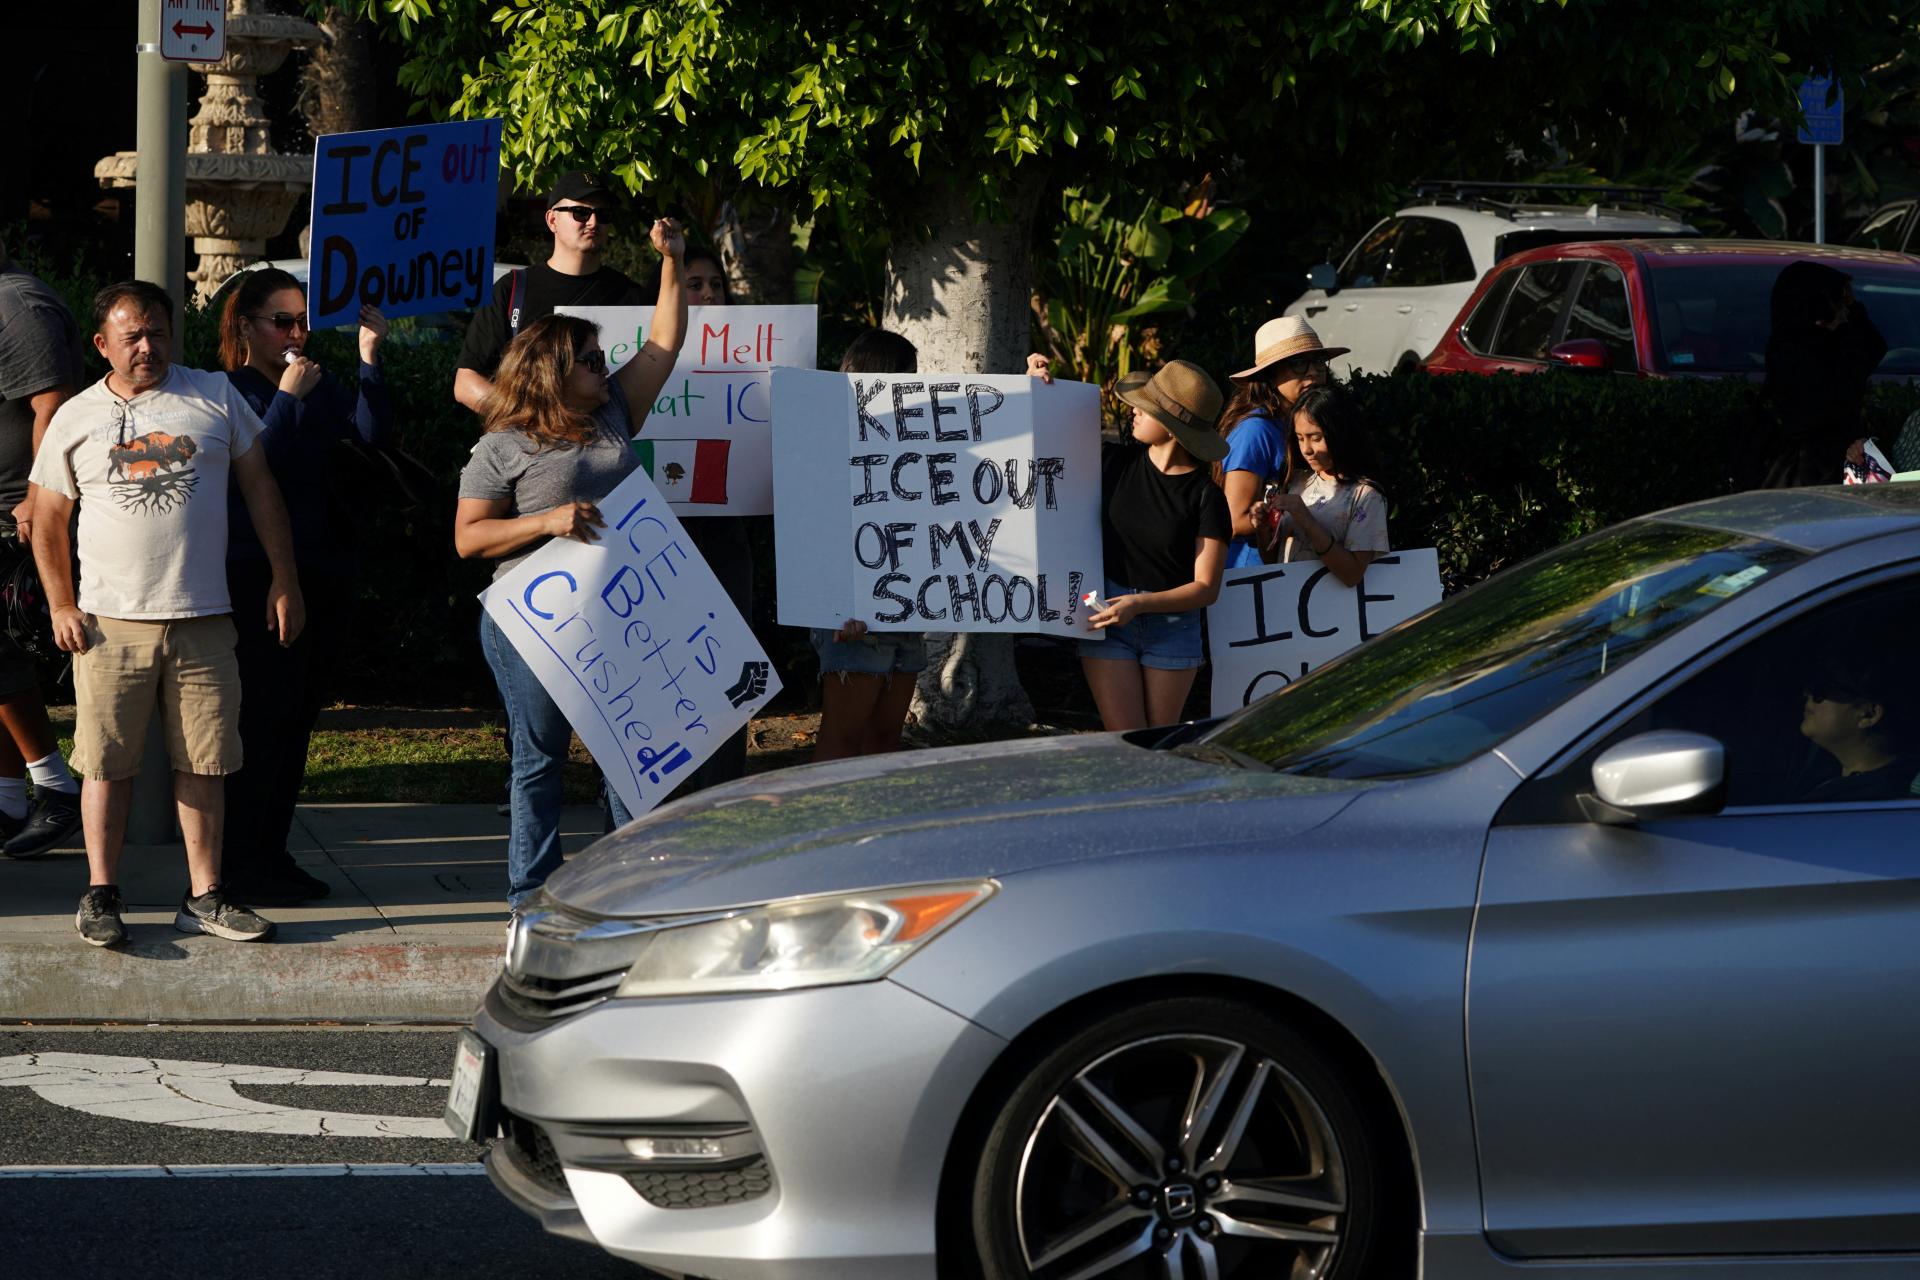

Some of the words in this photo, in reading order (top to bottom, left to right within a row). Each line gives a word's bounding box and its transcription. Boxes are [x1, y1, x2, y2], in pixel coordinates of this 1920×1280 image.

[323, 135, 428, 215] ICE
[394, 207, 427, 240] OF
[319, 235, 485, 317] Downey
[511, 308, 519, 328] EOS
[702, 323, 783, 365] Melt
[727, 382, 768, 424] IC
[854, 379, 1004, 442] KEEP
[848, 452, 960, 506] ICE
[972, 457, 1065, 511] OUT
[854, 521, 917, 572] OF
[928, 518, 1002, 572] MY
[616, 498, 687, 600] ICE
[687, 612, 721, 675] is
[873, 571, 1084, 625] SCHOOL!
[1226, 556, 1401, 647] ICE
[601, 565, 709, 734] Better
